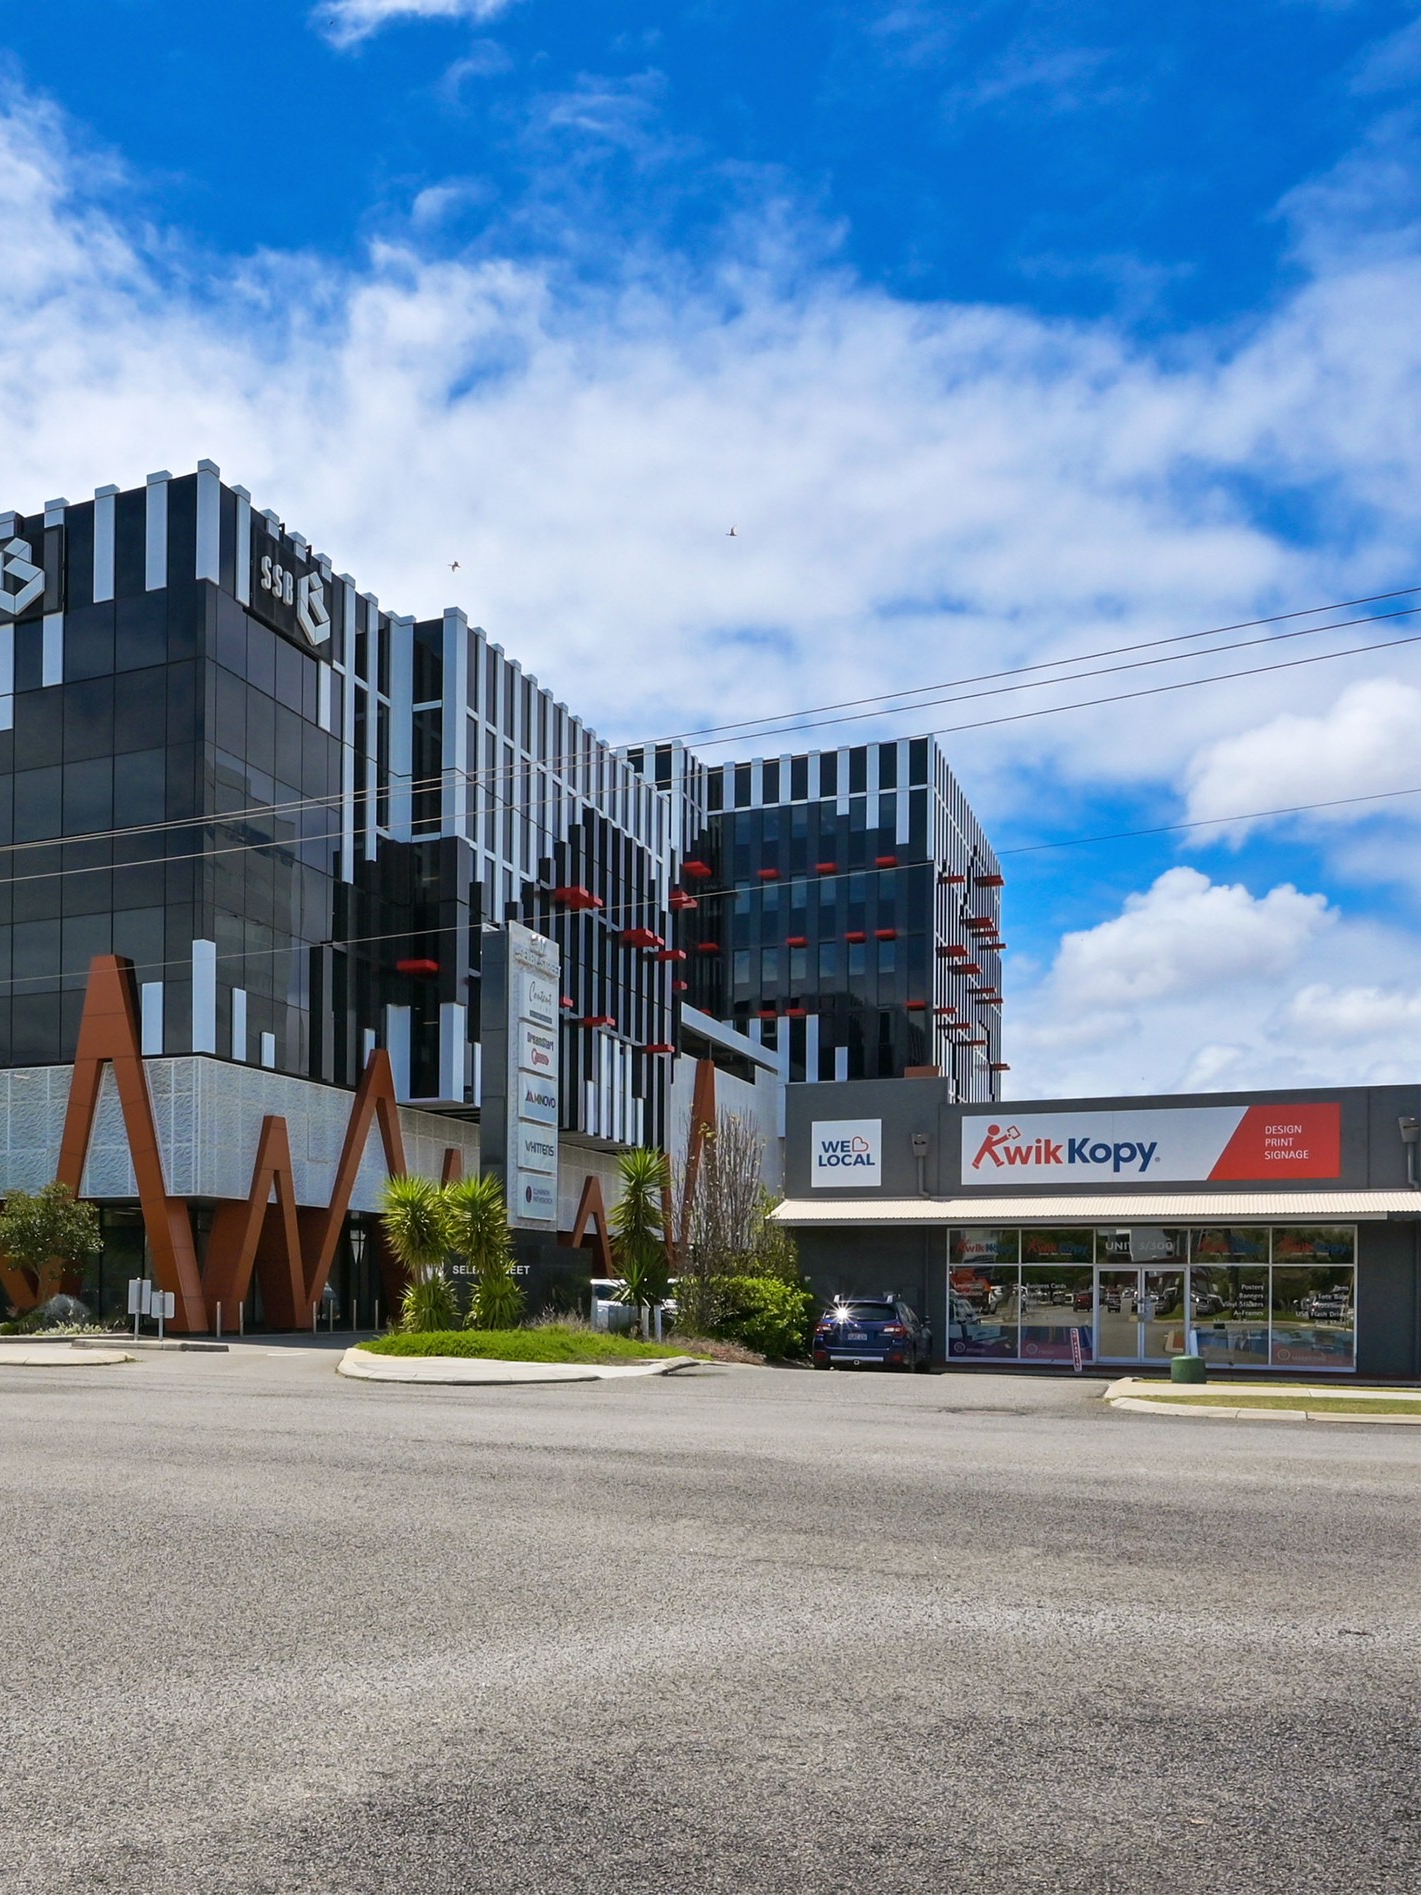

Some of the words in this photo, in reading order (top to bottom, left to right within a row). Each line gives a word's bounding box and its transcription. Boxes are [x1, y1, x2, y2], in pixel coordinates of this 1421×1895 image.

[261, 555, 293, 606] SSB
[1265, 1125, 1302, 1134] DESIGN
[821, 1140, 851, 1153] WE
[1265, 1137, 1294, 1147] PRINT
[818, 1154, 876, 1167] LOCAL
[1068, 1137, 1157, 1172] Kopy
[1264, 1150, 1309, 1160] SIGNAGE
